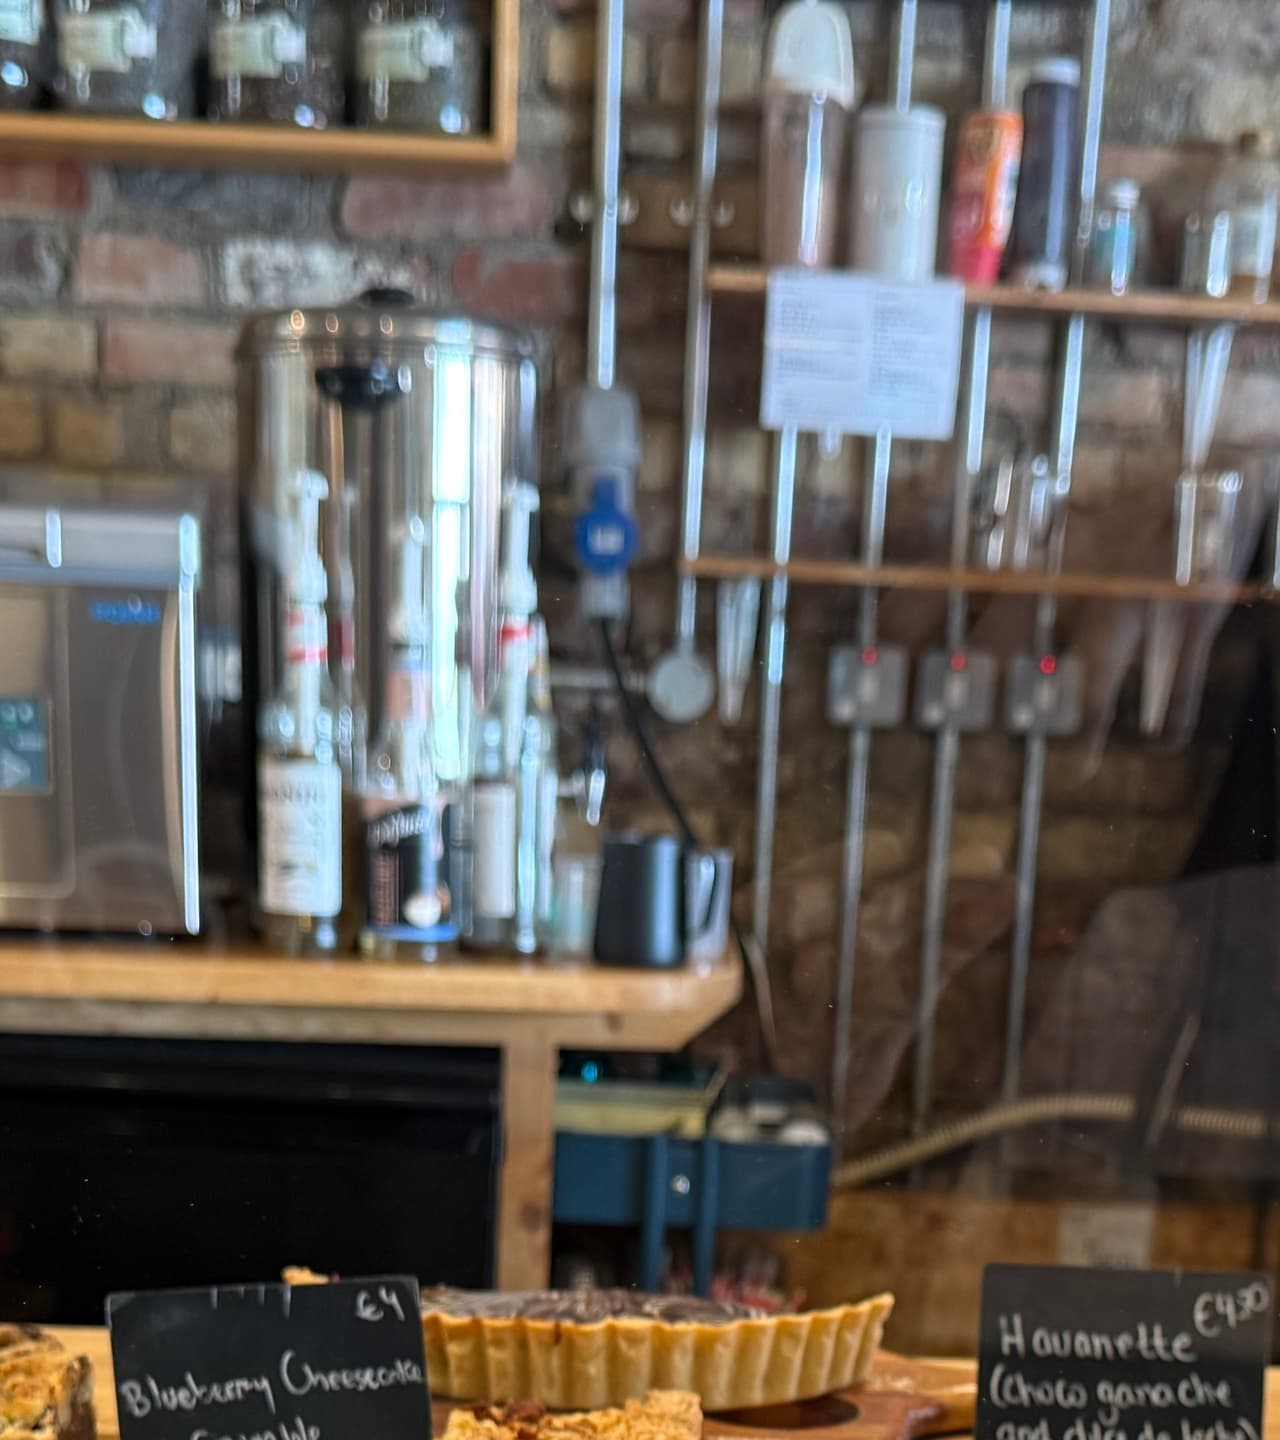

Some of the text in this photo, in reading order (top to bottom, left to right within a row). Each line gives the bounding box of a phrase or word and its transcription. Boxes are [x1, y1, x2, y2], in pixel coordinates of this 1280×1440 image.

[356, 1285, 405, 1321] €4
[121, 1350, 426, 1417] Blueberry Cheesecake
